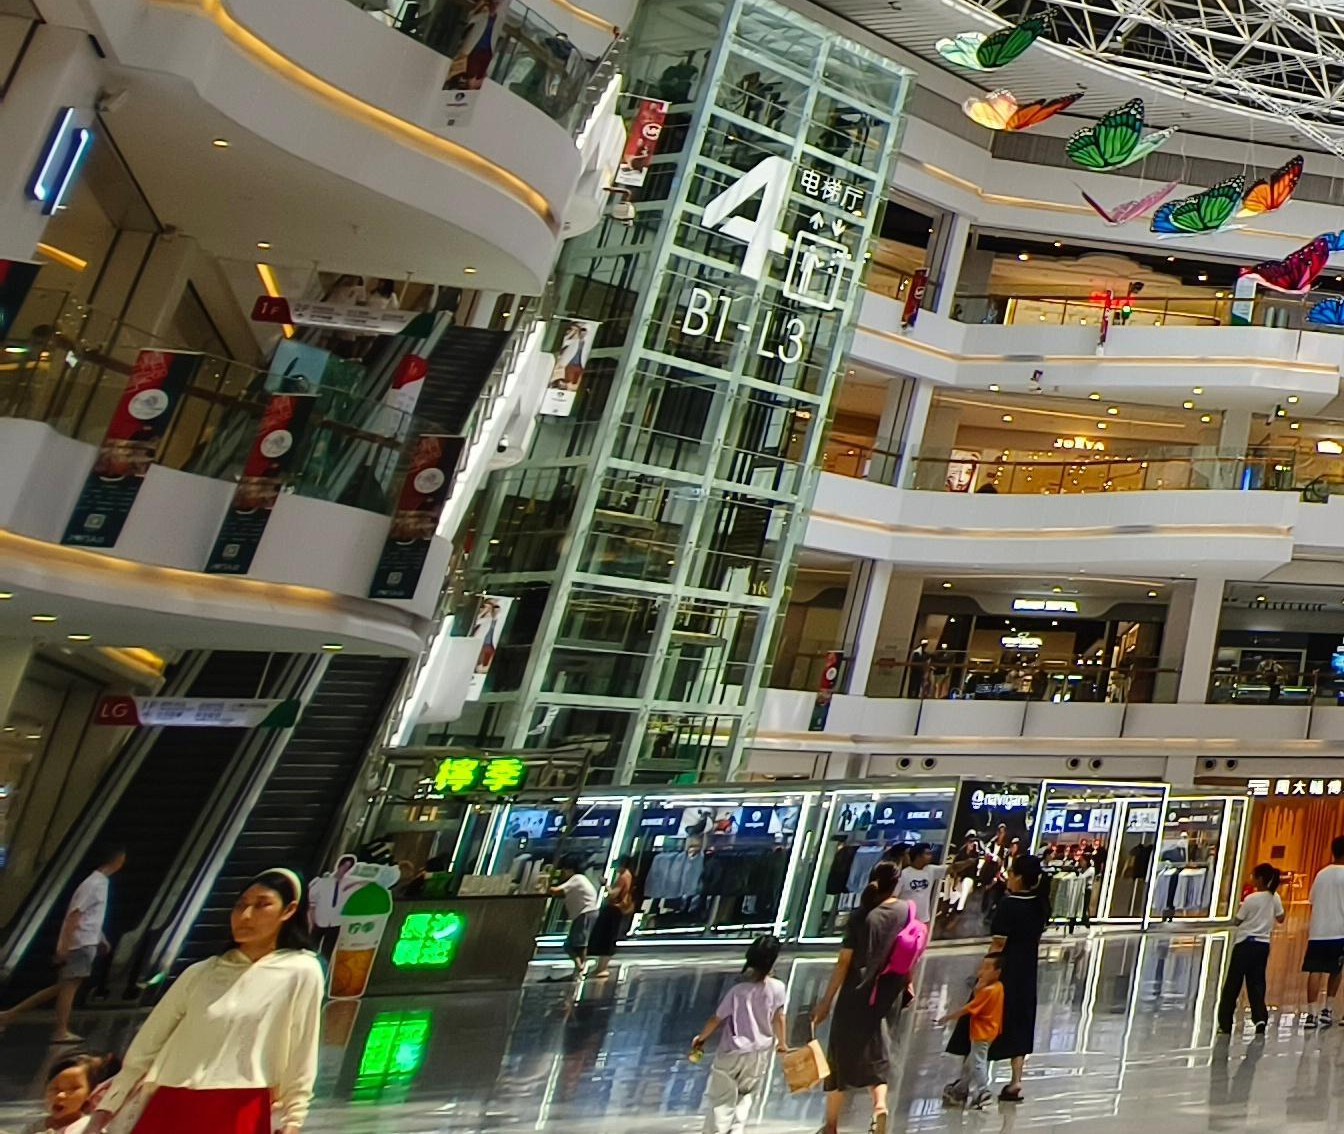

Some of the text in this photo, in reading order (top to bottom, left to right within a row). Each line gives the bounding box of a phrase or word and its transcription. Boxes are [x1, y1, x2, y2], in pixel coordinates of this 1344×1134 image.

[799, 169, 865, 212] 电梯厅
[701, 155, 793, 281] 4
[101, 703, 129, 718] LG
[983, 793, 1030, 811] navigare
